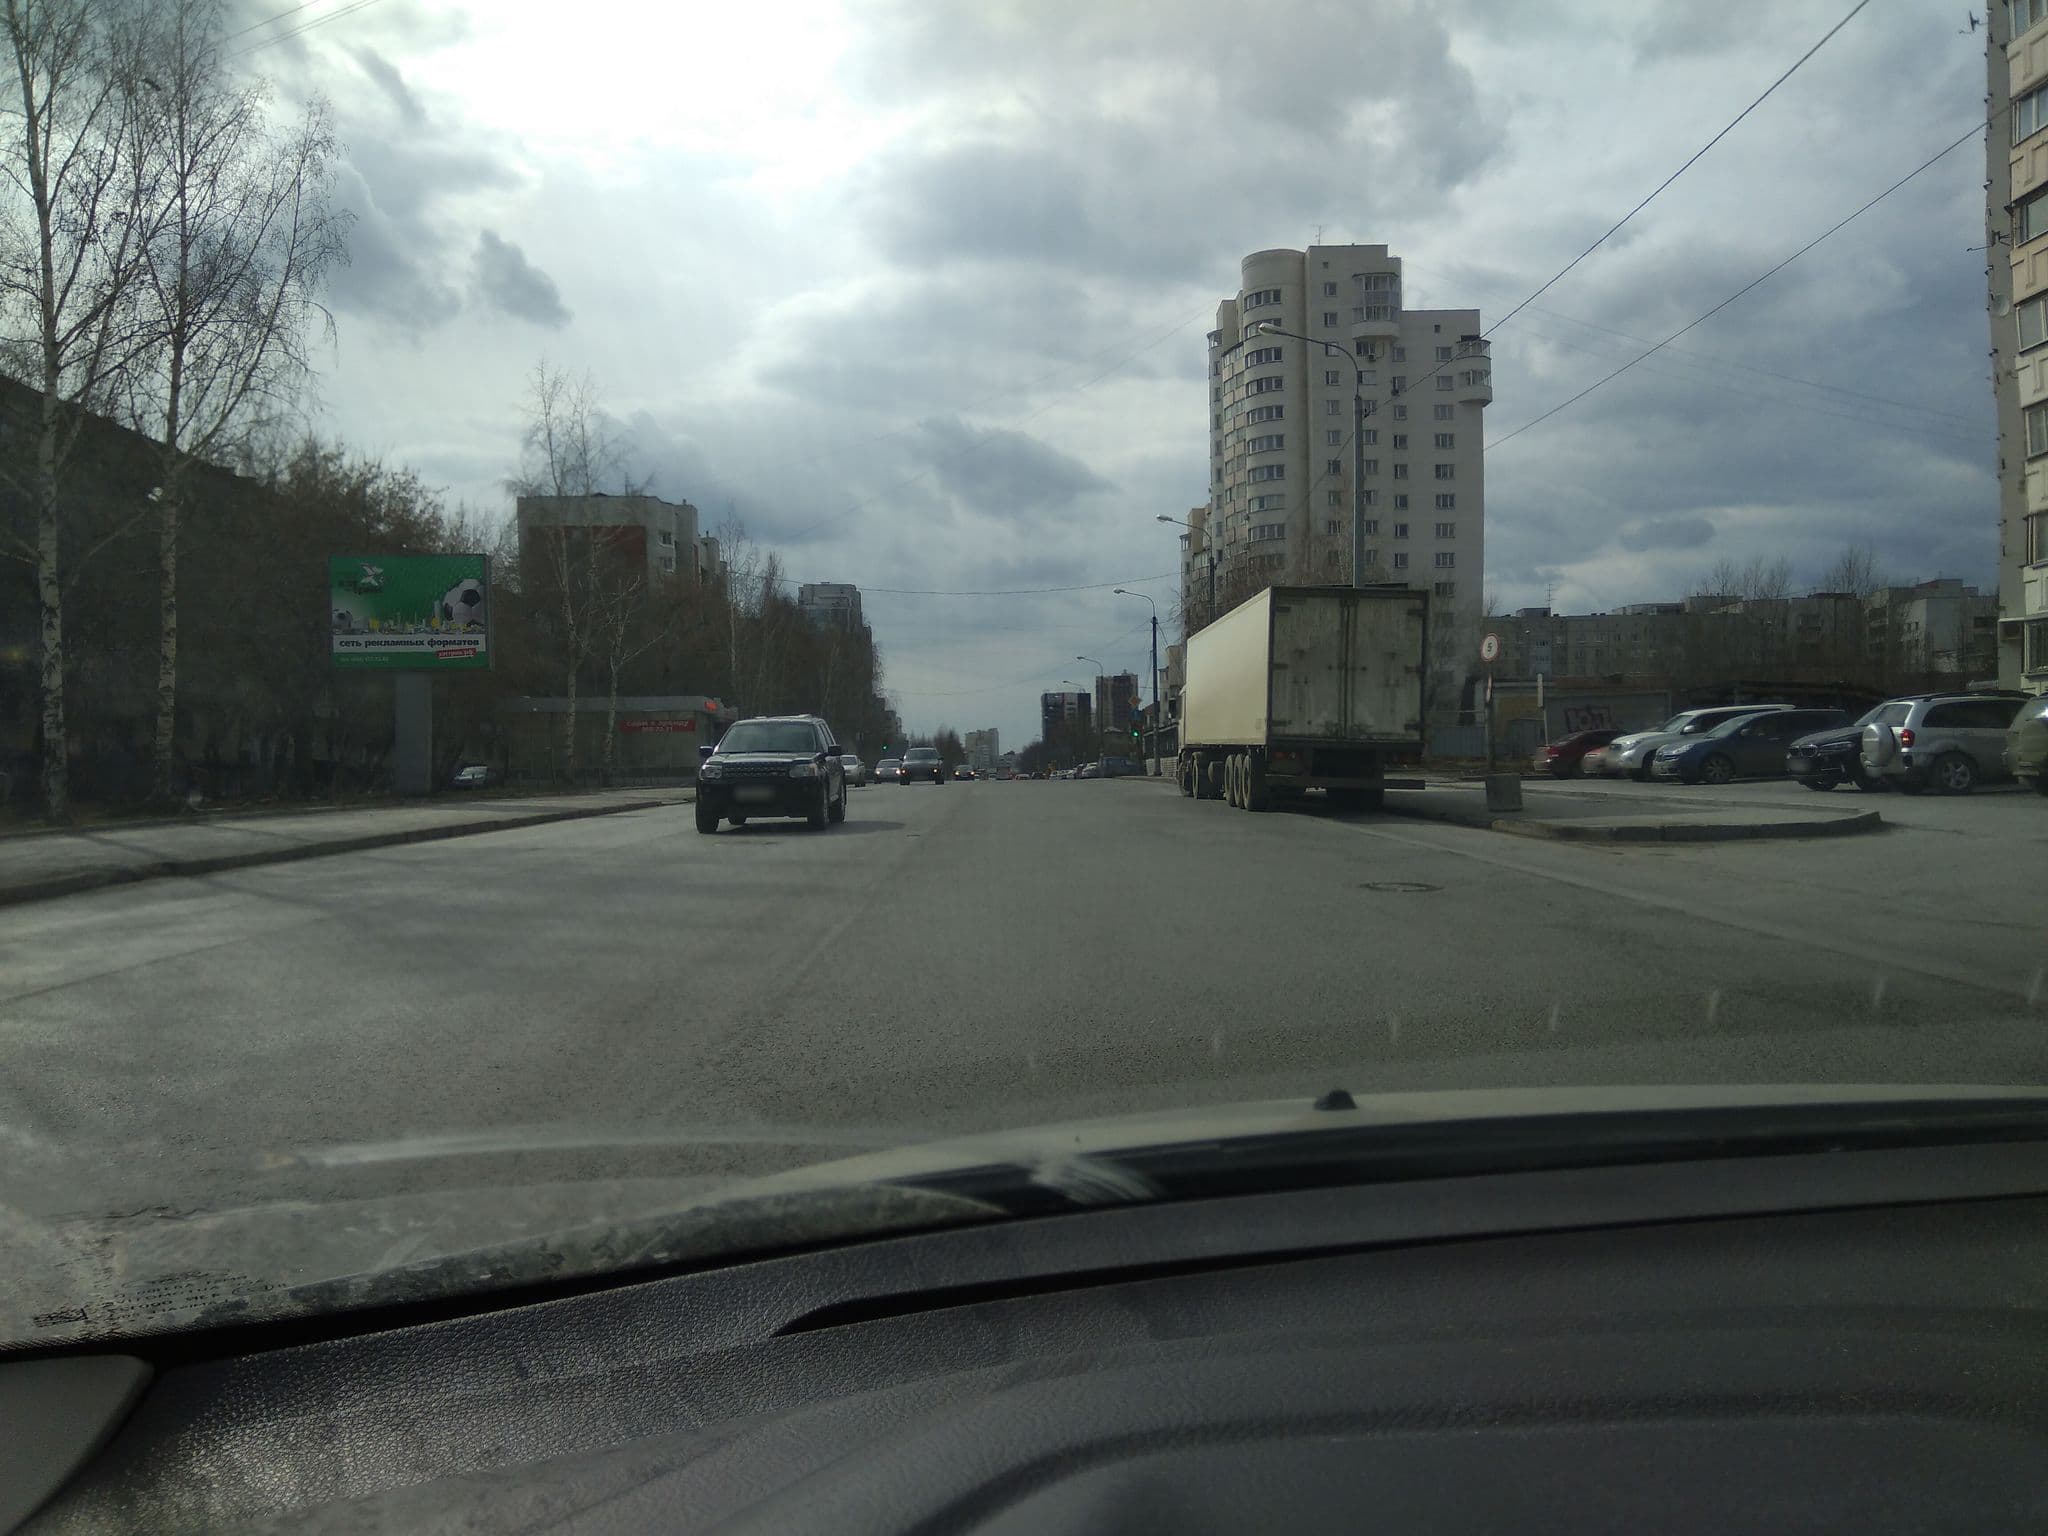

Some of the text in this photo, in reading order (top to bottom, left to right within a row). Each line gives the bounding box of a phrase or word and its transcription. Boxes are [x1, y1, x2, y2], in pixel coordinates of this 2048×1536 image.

[339, 637, 480, 649] сеть рекламных форматов
[1487, 642, 1493, 652] 5
